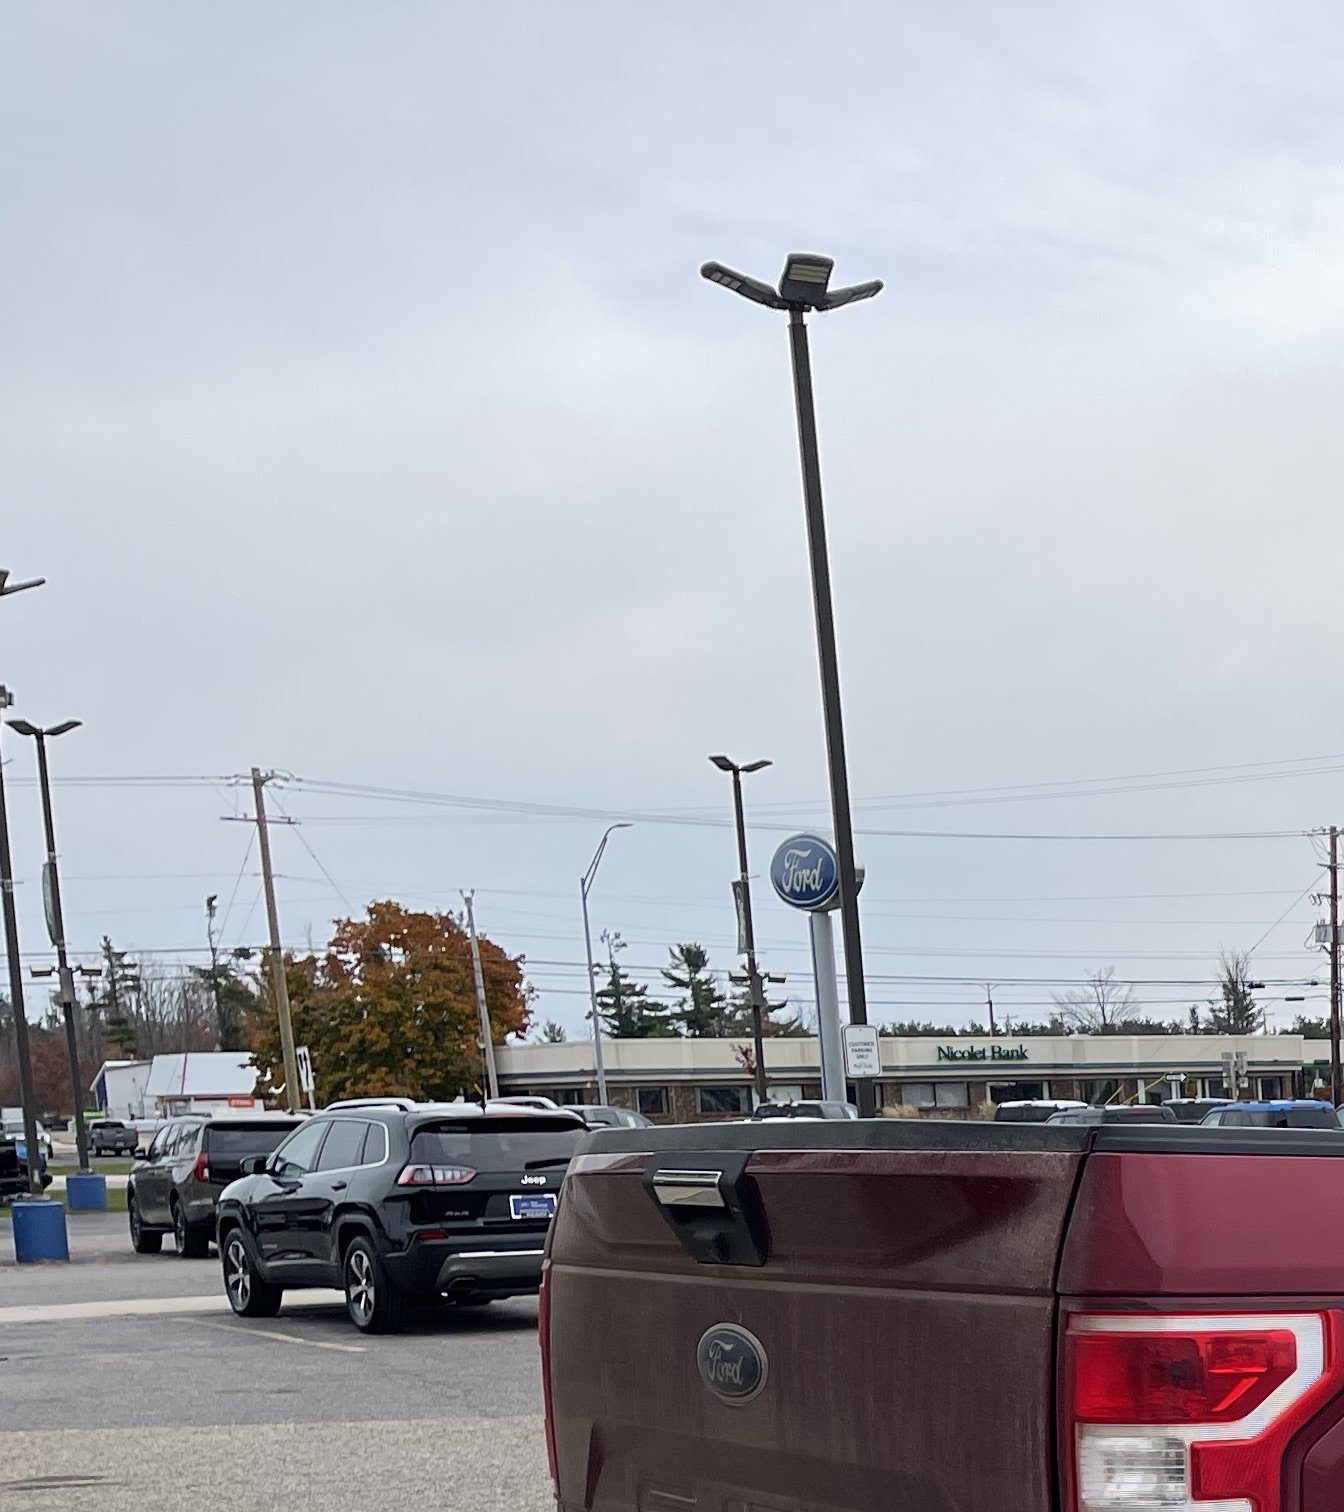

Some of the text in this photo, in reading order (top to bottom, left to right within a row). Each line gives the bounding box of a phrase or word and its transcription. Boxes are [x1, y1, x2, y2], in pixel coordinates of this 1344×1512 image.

[782, 849, 824, 893] Ford
[937, 1044, 1029, 1061] Nicolet Bank
[520, 1174, 547, 1186] Jeep
[706, 1339, 743, 1386] Ford
